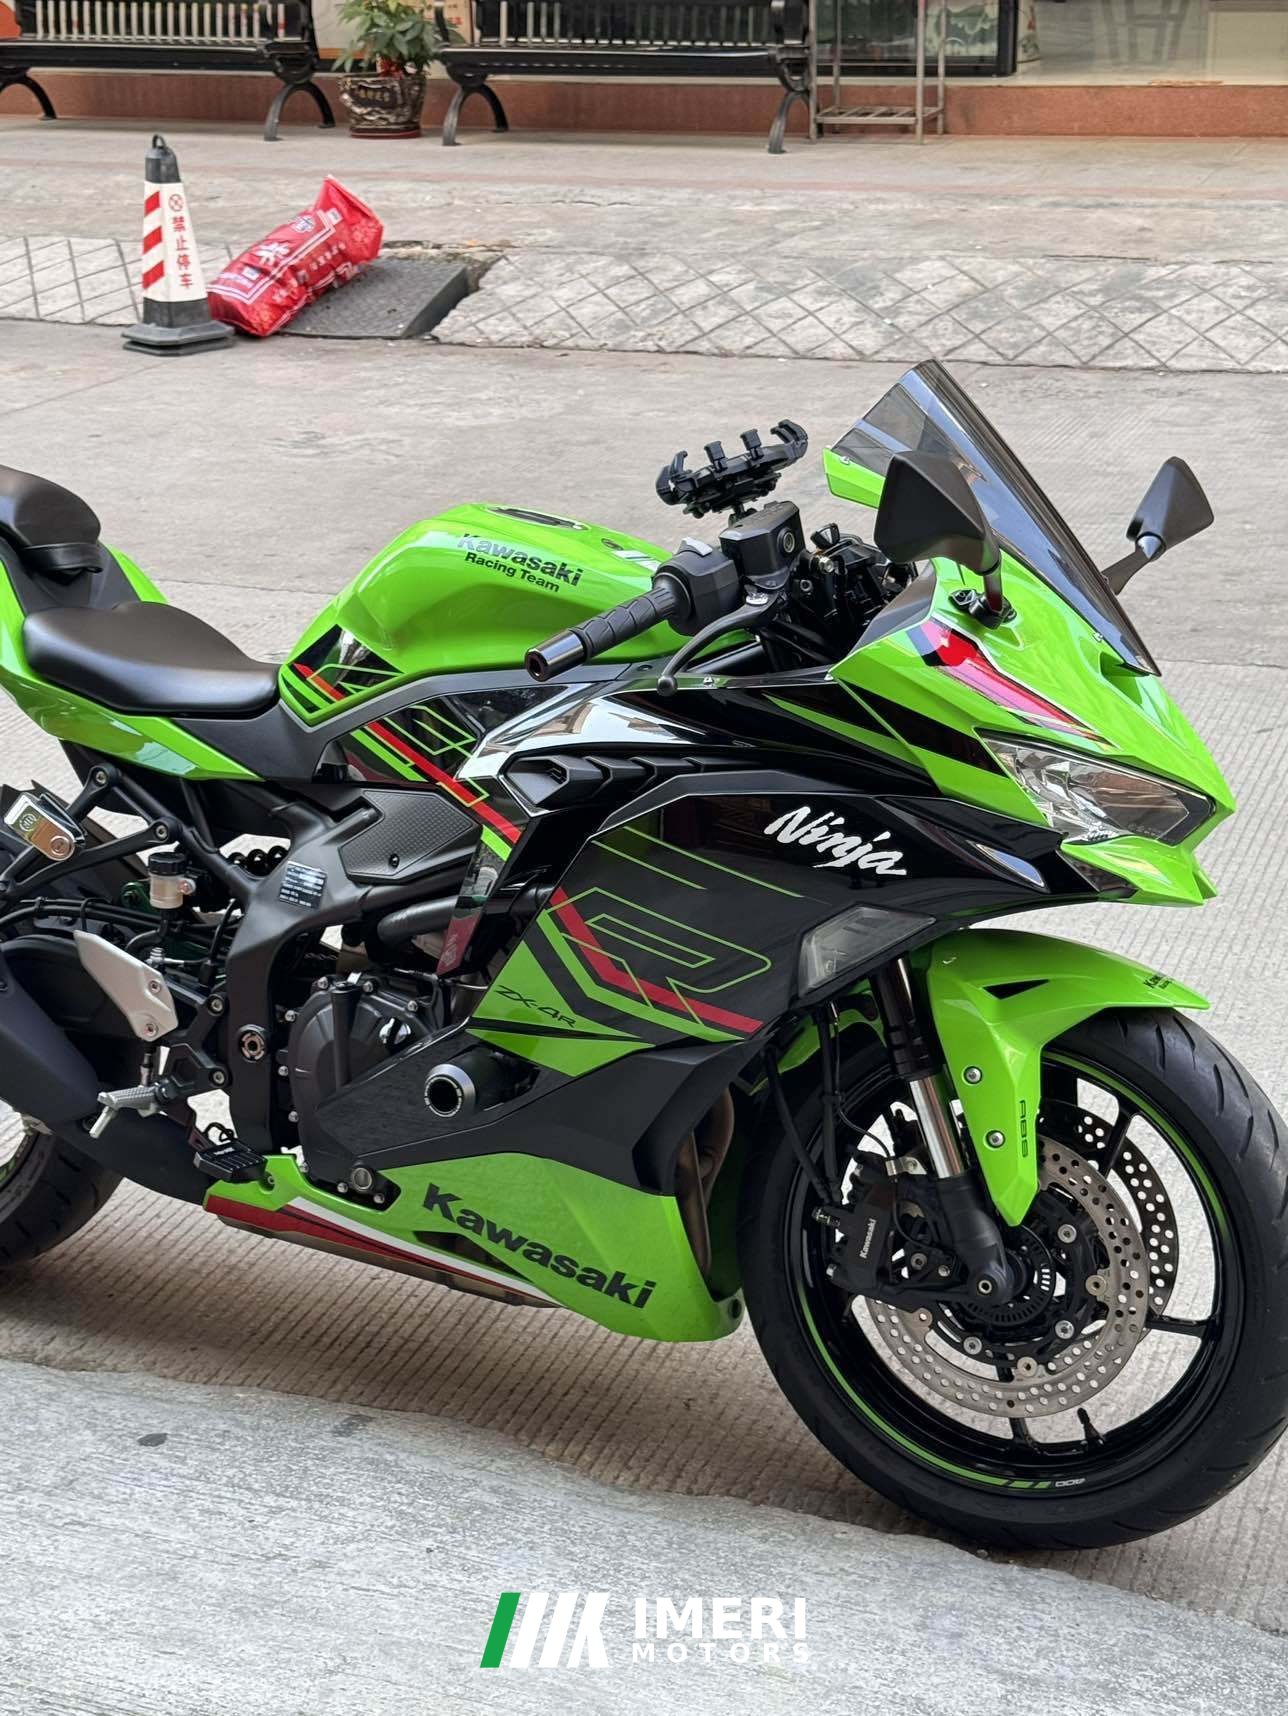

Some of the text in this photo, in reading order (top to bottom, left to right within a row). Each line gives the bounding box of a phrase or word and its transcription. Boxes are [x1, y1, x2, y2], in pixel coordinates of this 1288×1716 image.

[172, 216, 193, 289] 禁止停车
[457, 533, 584, 586] Kawasaki
[464, 551, 560, 593] Racing Team
[763, 806, 907, 875] Ninja
[494, 984, 577, 1028] ZX-4R
[1019, 1099, 1030, 1158] ABS
[423, 1182, 657, 1309] Kawasaki
[859, 1217, 877, 1259] Kawasaki
